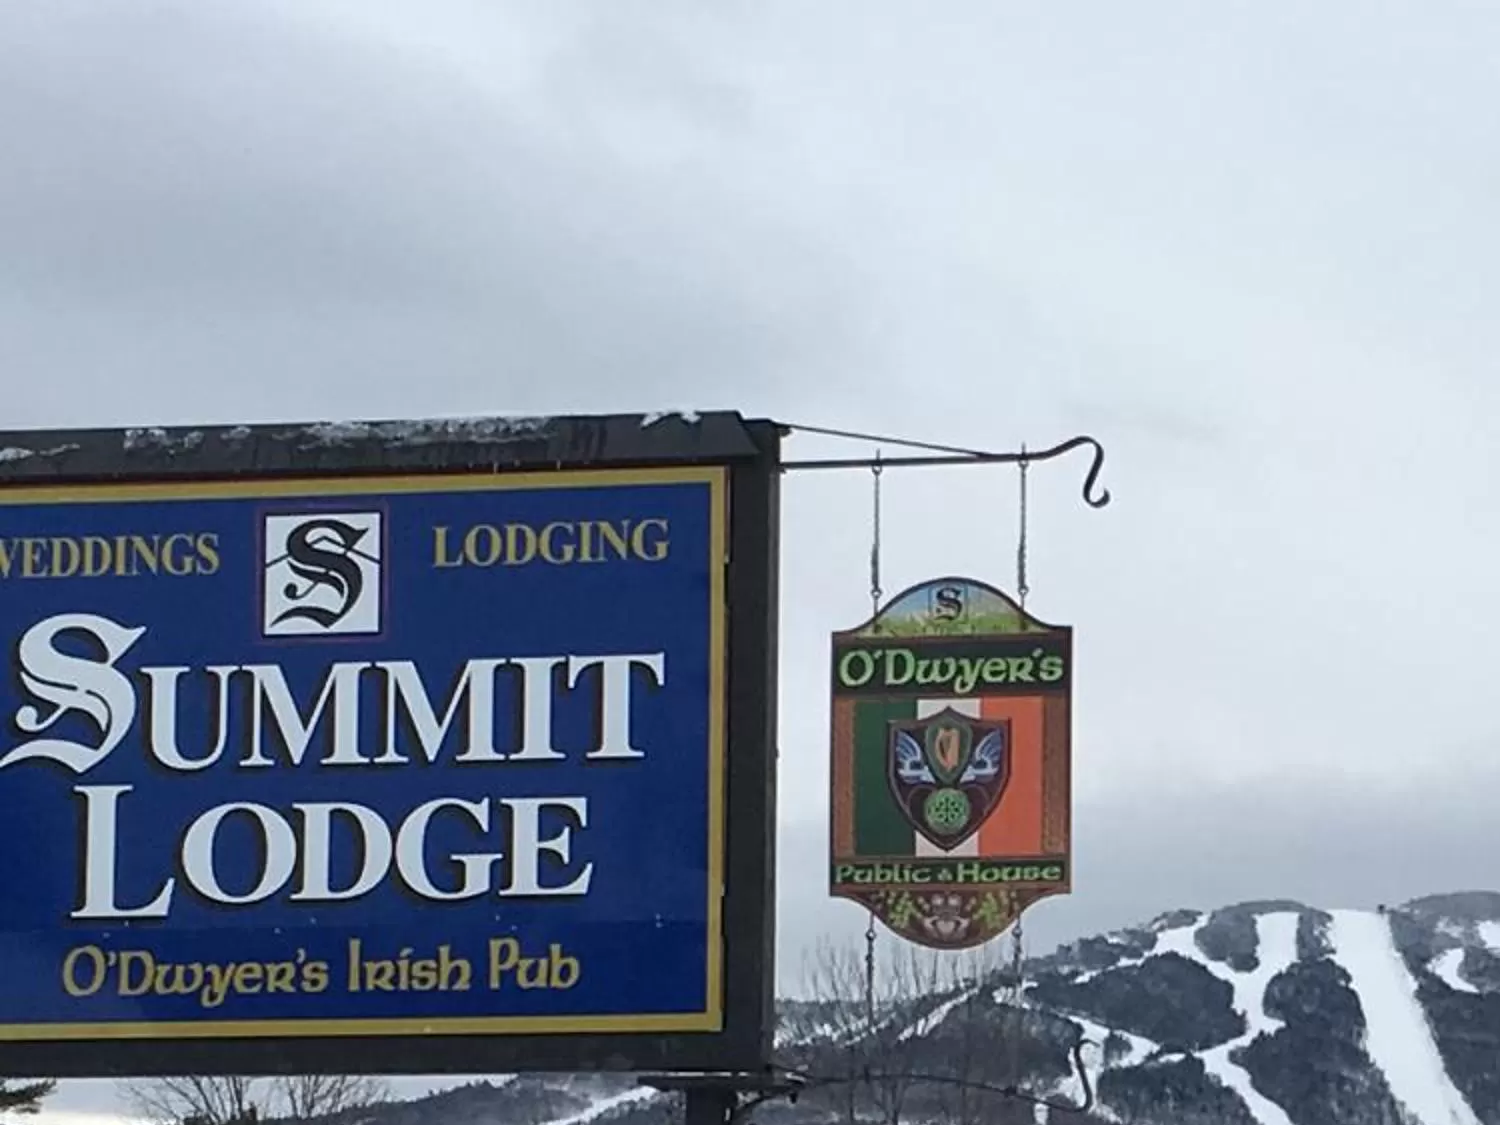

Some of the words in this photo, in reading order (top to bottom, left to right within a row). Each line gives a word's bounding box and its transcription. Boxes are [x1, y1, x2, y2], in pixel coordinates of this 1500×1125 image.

[432, 519, 671, 569] LODGING
[0, 612, 665, 773] SUMMIT
[838, 647, 1065, 694] O'Dwyer's
[70, 785, 593, 920] LODGE
[834, 864, 932, 883] Public
[956, 861, 1061, 883] House
[62, 944, 329, 1007] O'Dwyer's
[347, 938, 471, 992] Irish
[489, 937, 580, 990] Pub
